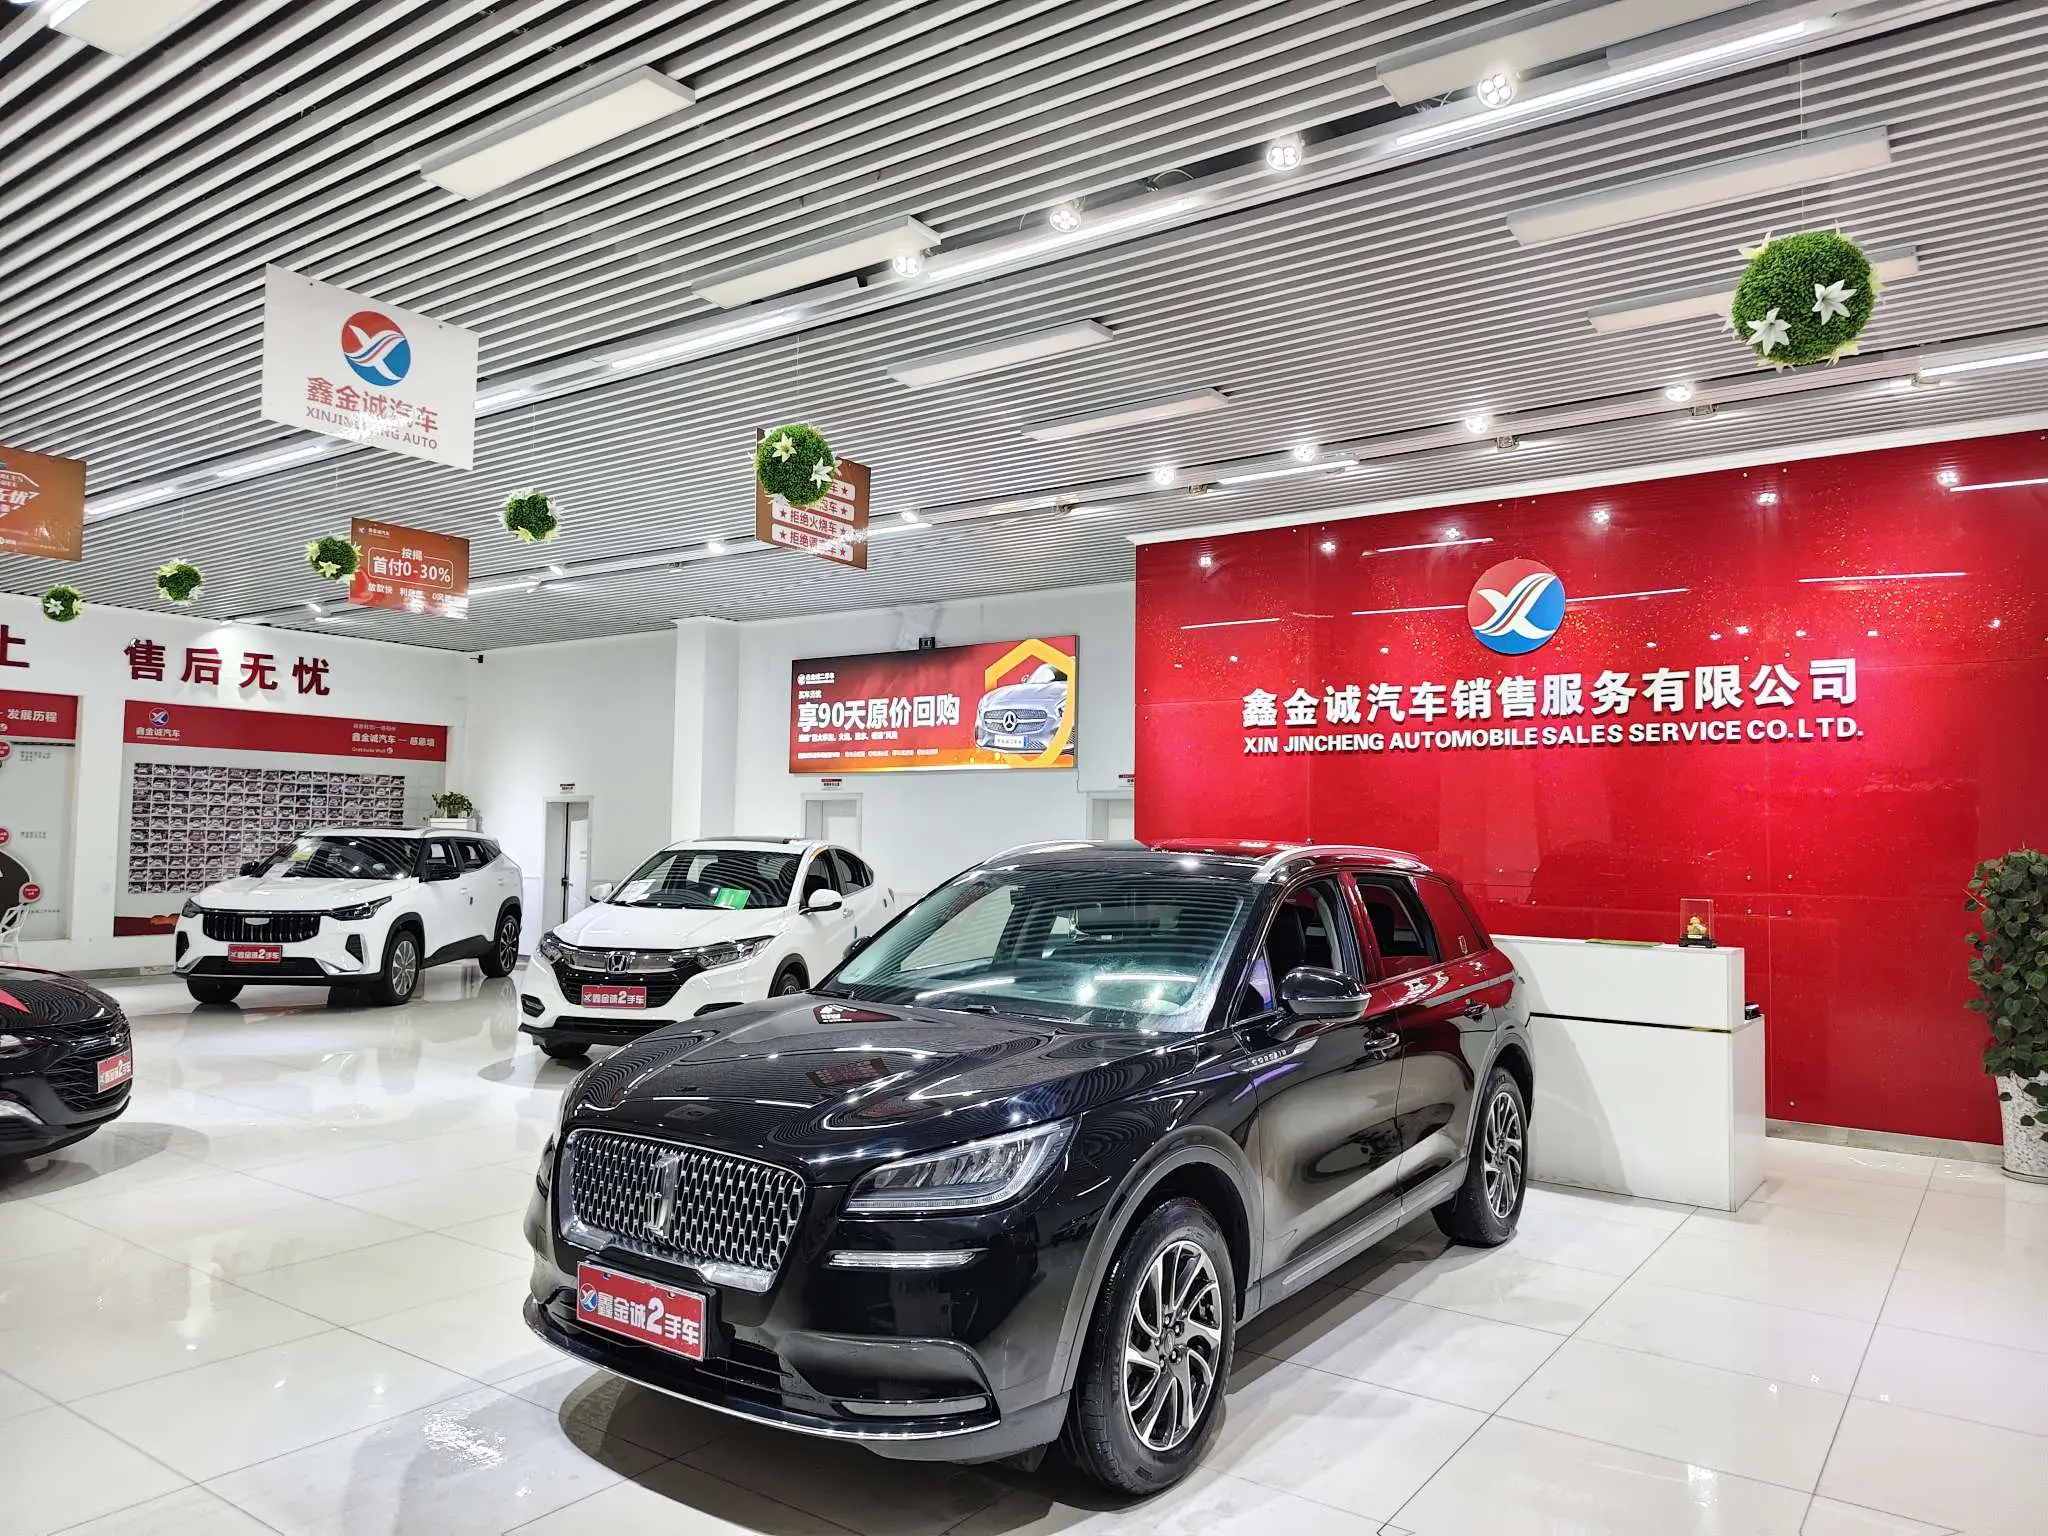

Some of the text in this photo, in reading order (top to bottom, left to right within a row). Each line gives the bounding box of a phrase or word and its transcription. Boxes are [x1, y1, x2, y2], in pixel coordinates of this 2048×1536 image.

[307, 377, 438, 432] 鑫金诚汽车
[403, 433, 437, 449] AUTO
[790, 510, 837, 534] 拒绝火烧车
[373, 555, 451, 583] 首付0-30%
[124, 639, 330, 695] 售后无忧
[1242, 658, 1856, 728] 鑫金诚汽车销售服务有限公司
[7, 709, 57, 722] 发展历程
[797, 694, 960, 732] 享90天原价回购
[1243, 736, 1278, 753] XIN
[1283, 733, 1384, 752] JINCHENG
[1389, 727, 1537, 750] AUTOMOBILE
[1541, 723, 1622, 746] SALES
[1628, 720, 1742, 743] SERVICE
[597, 1291, 700, 1345] 鑫金诚2手车
